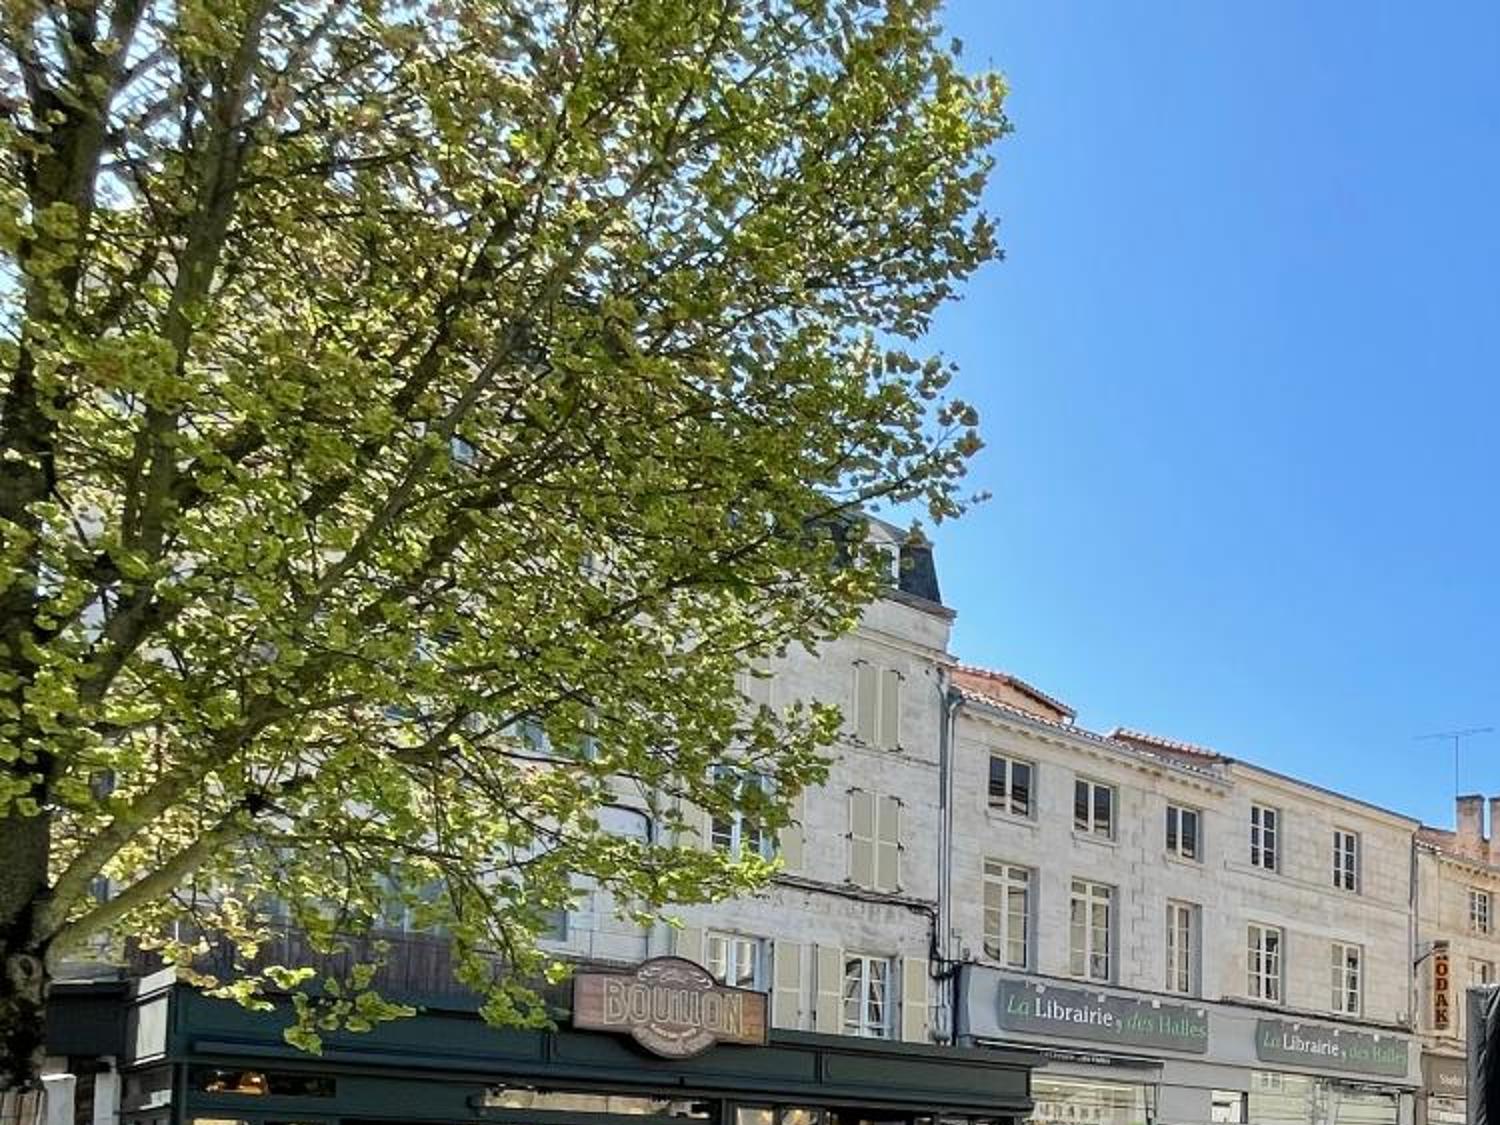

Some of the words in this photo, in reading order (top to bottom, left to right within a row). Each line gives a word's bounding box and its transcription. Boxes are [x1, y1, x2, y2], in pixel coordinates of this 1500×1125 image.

[604, 976, 743, 1037] BOUILLON
[1007, 995, 1030, 1016] La
[1035, 997, 1113, 1027] Librairie
[1127, 1011, 1154, 1032] des
[1159, 1014, 1207, 1039] Halles
[1283, 1034, 1339, 1056] Librairie
